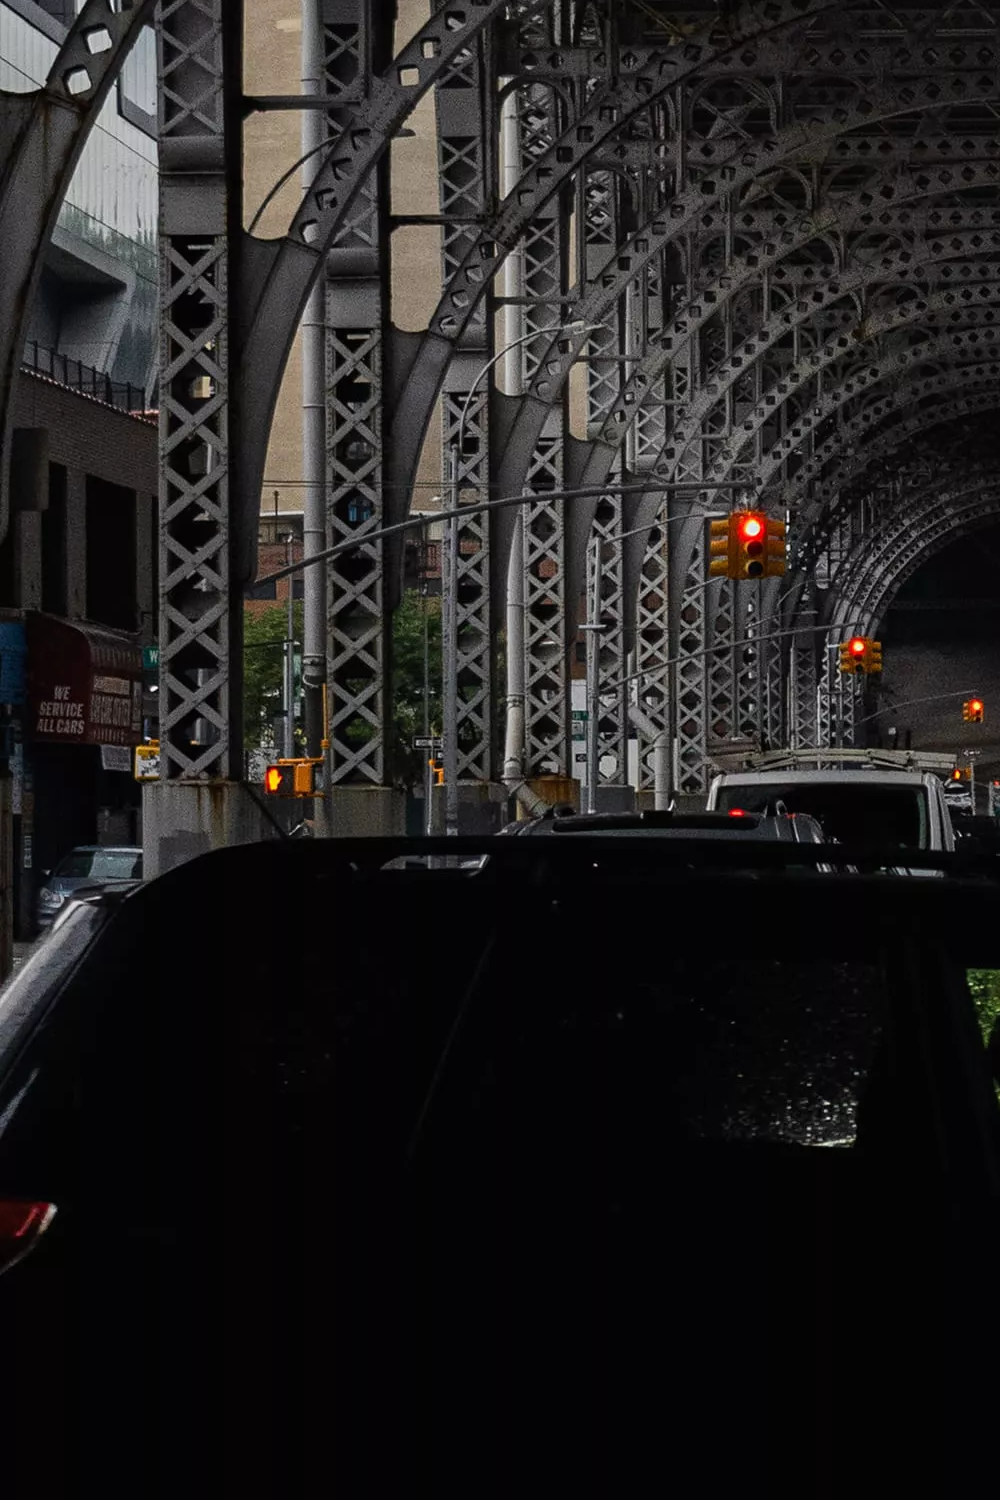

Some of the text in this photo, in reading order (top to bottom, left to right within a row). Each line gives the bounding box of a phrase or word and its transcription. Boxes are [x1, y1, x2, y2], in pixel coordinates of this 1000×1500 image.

[54, 685, 71, 700] WE
[39, 702, 84, 718] SERVICE
[36, 718, 85, 734] ALL CARS
